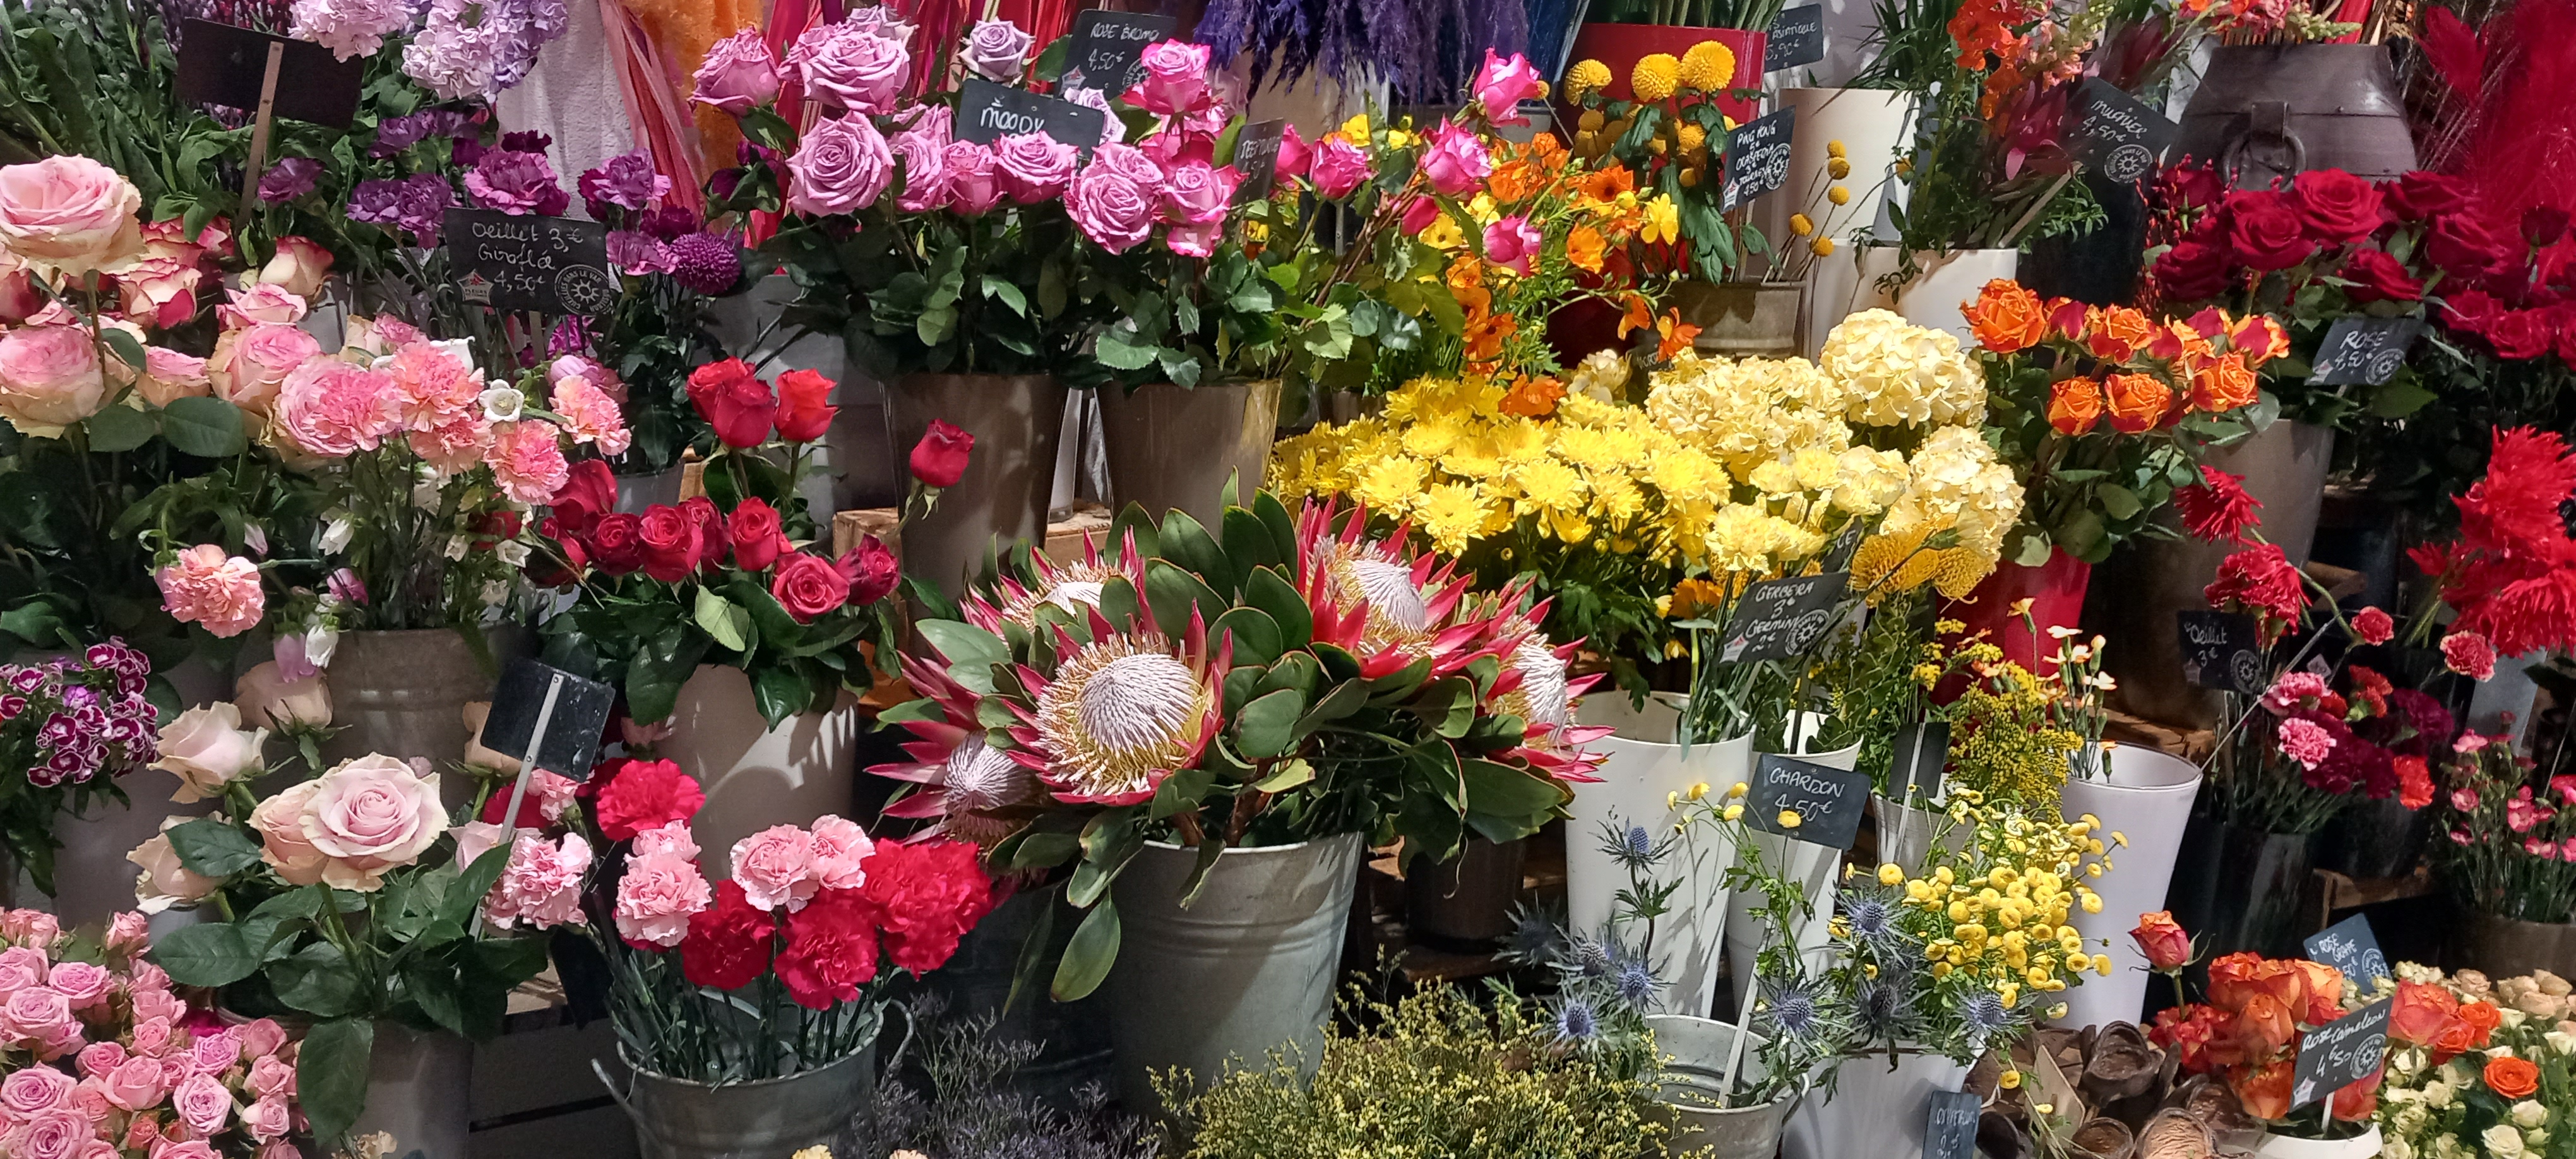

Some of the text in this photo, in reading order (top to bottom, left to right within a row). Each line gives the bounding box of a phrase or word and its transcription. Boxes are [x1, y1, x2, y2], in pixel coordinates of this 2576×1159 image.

[1090, 22, 1119, 39] ROSE
[472, 223, 539, 242] Oeillet
[2340, 330, 2388, 350] ROSE
[1755, 581, 1815, 602] GERBERA
[1769, 767, 1846, 798] CHARDON
